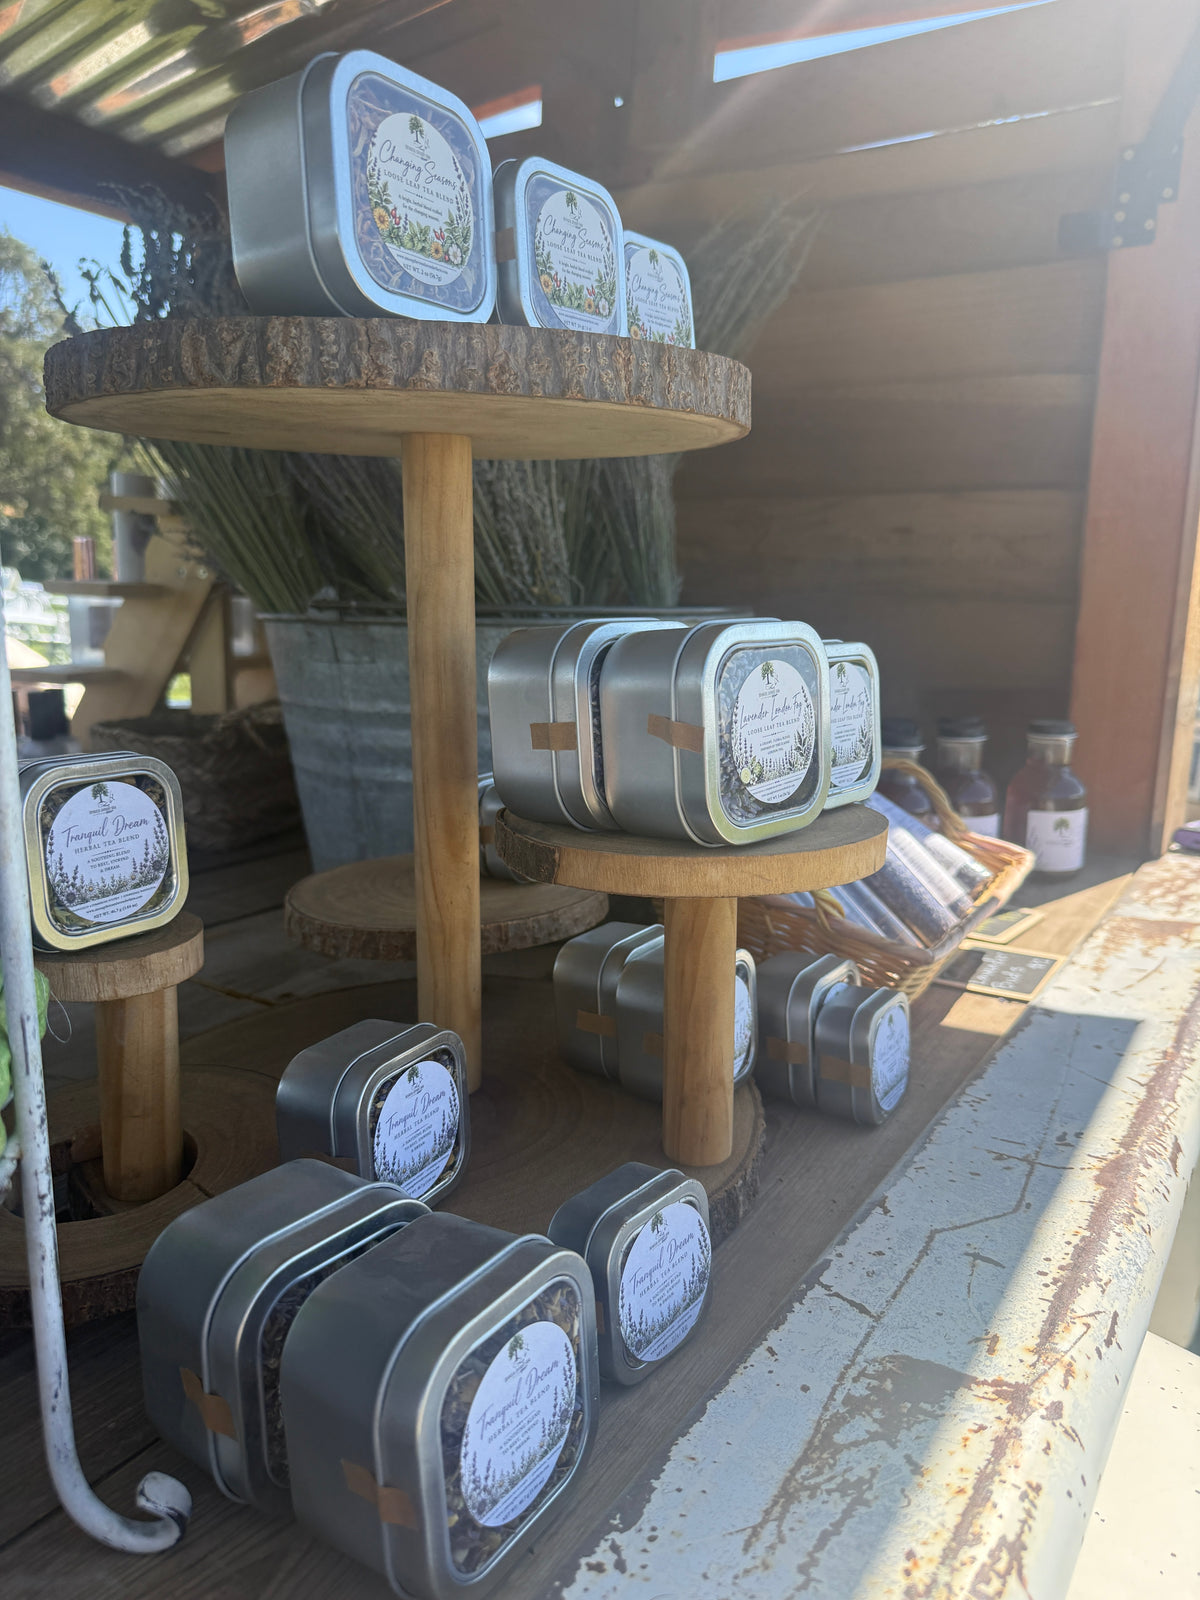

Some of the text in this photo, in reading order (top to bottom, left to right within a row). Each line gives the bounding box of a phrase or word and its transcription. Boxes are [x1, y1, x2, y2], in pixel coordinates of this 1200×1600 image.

[379, 140, 424, 179] Changing
[425, 161, 457, 190] Seasons
[384, 170, 454, 205] LOOSE LEAF TEA BLEND
[543, 215, 576, 246] Changing
[578, 228, 605, 251] Seasons
[547, 241, 563, 252] LOOSE
[564, 247, 577, 255] LEAF
[587, 254, 602, 264] BLEND
[632, 274, 658, 299] Changing
[659, 285, 680, 303] Seasons
[635, 296, 647, 305] LOOSE
[740, 690, 803, 729] Lavender London Fog
[842, 693, 857, 714] London
[748, 726, 763, 736] LOOSE
[764, 724, 774, 732] LEAF
[786, 718, 800, 727] BLEND
[61, 815, 150, 848] Tranquil Dream
[74, 843, 101, 854] HERBAL
[119, 834, 140, 843] BLEND
[91, 853, 115, 863] SOOTHING
[386, 1097, 419, 1136] Tranquil
[421, 1090, 446, 1114] Dream
[394, 1107, 440, 1140] HERBAL TEA BLEND
[629, 1246, 664, 1295] Tranquil
[668, 1232, 695, 1263] Dream
[639, 1252, 688, 1298] HERBAL TEA BLEND
[476, 1376, 522, 1441] Tranquil
[526, 1360, 560, 1399] Dream
[488, 1384, 551, 1444] HERBAL TEA BLEND
